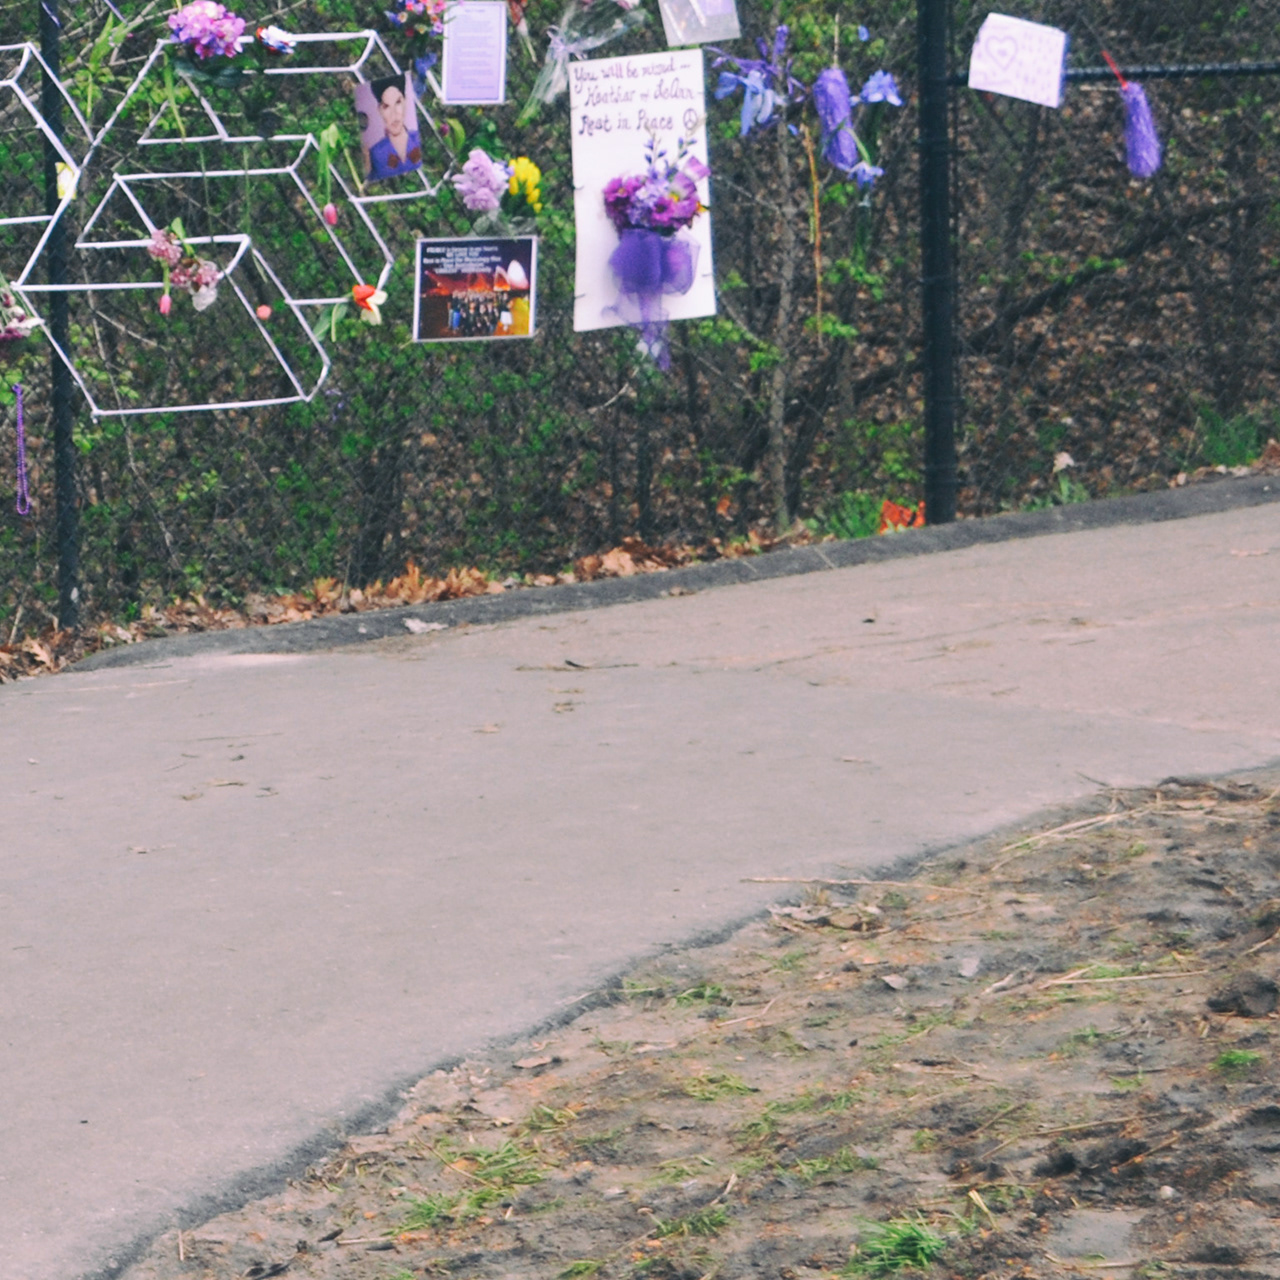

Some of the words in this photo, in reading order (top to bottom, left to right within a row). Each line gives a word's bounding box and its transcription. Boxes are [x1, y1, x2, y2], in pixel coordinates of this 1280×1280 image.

[573, 67, 598, 94] You
[600, 62, 624, 79] will
[626, 60, 639, 78] be
[578, 114, 612, 137] Rest
[616, 112, 631, 131] in
[636, 108, 674, 131] Peace
